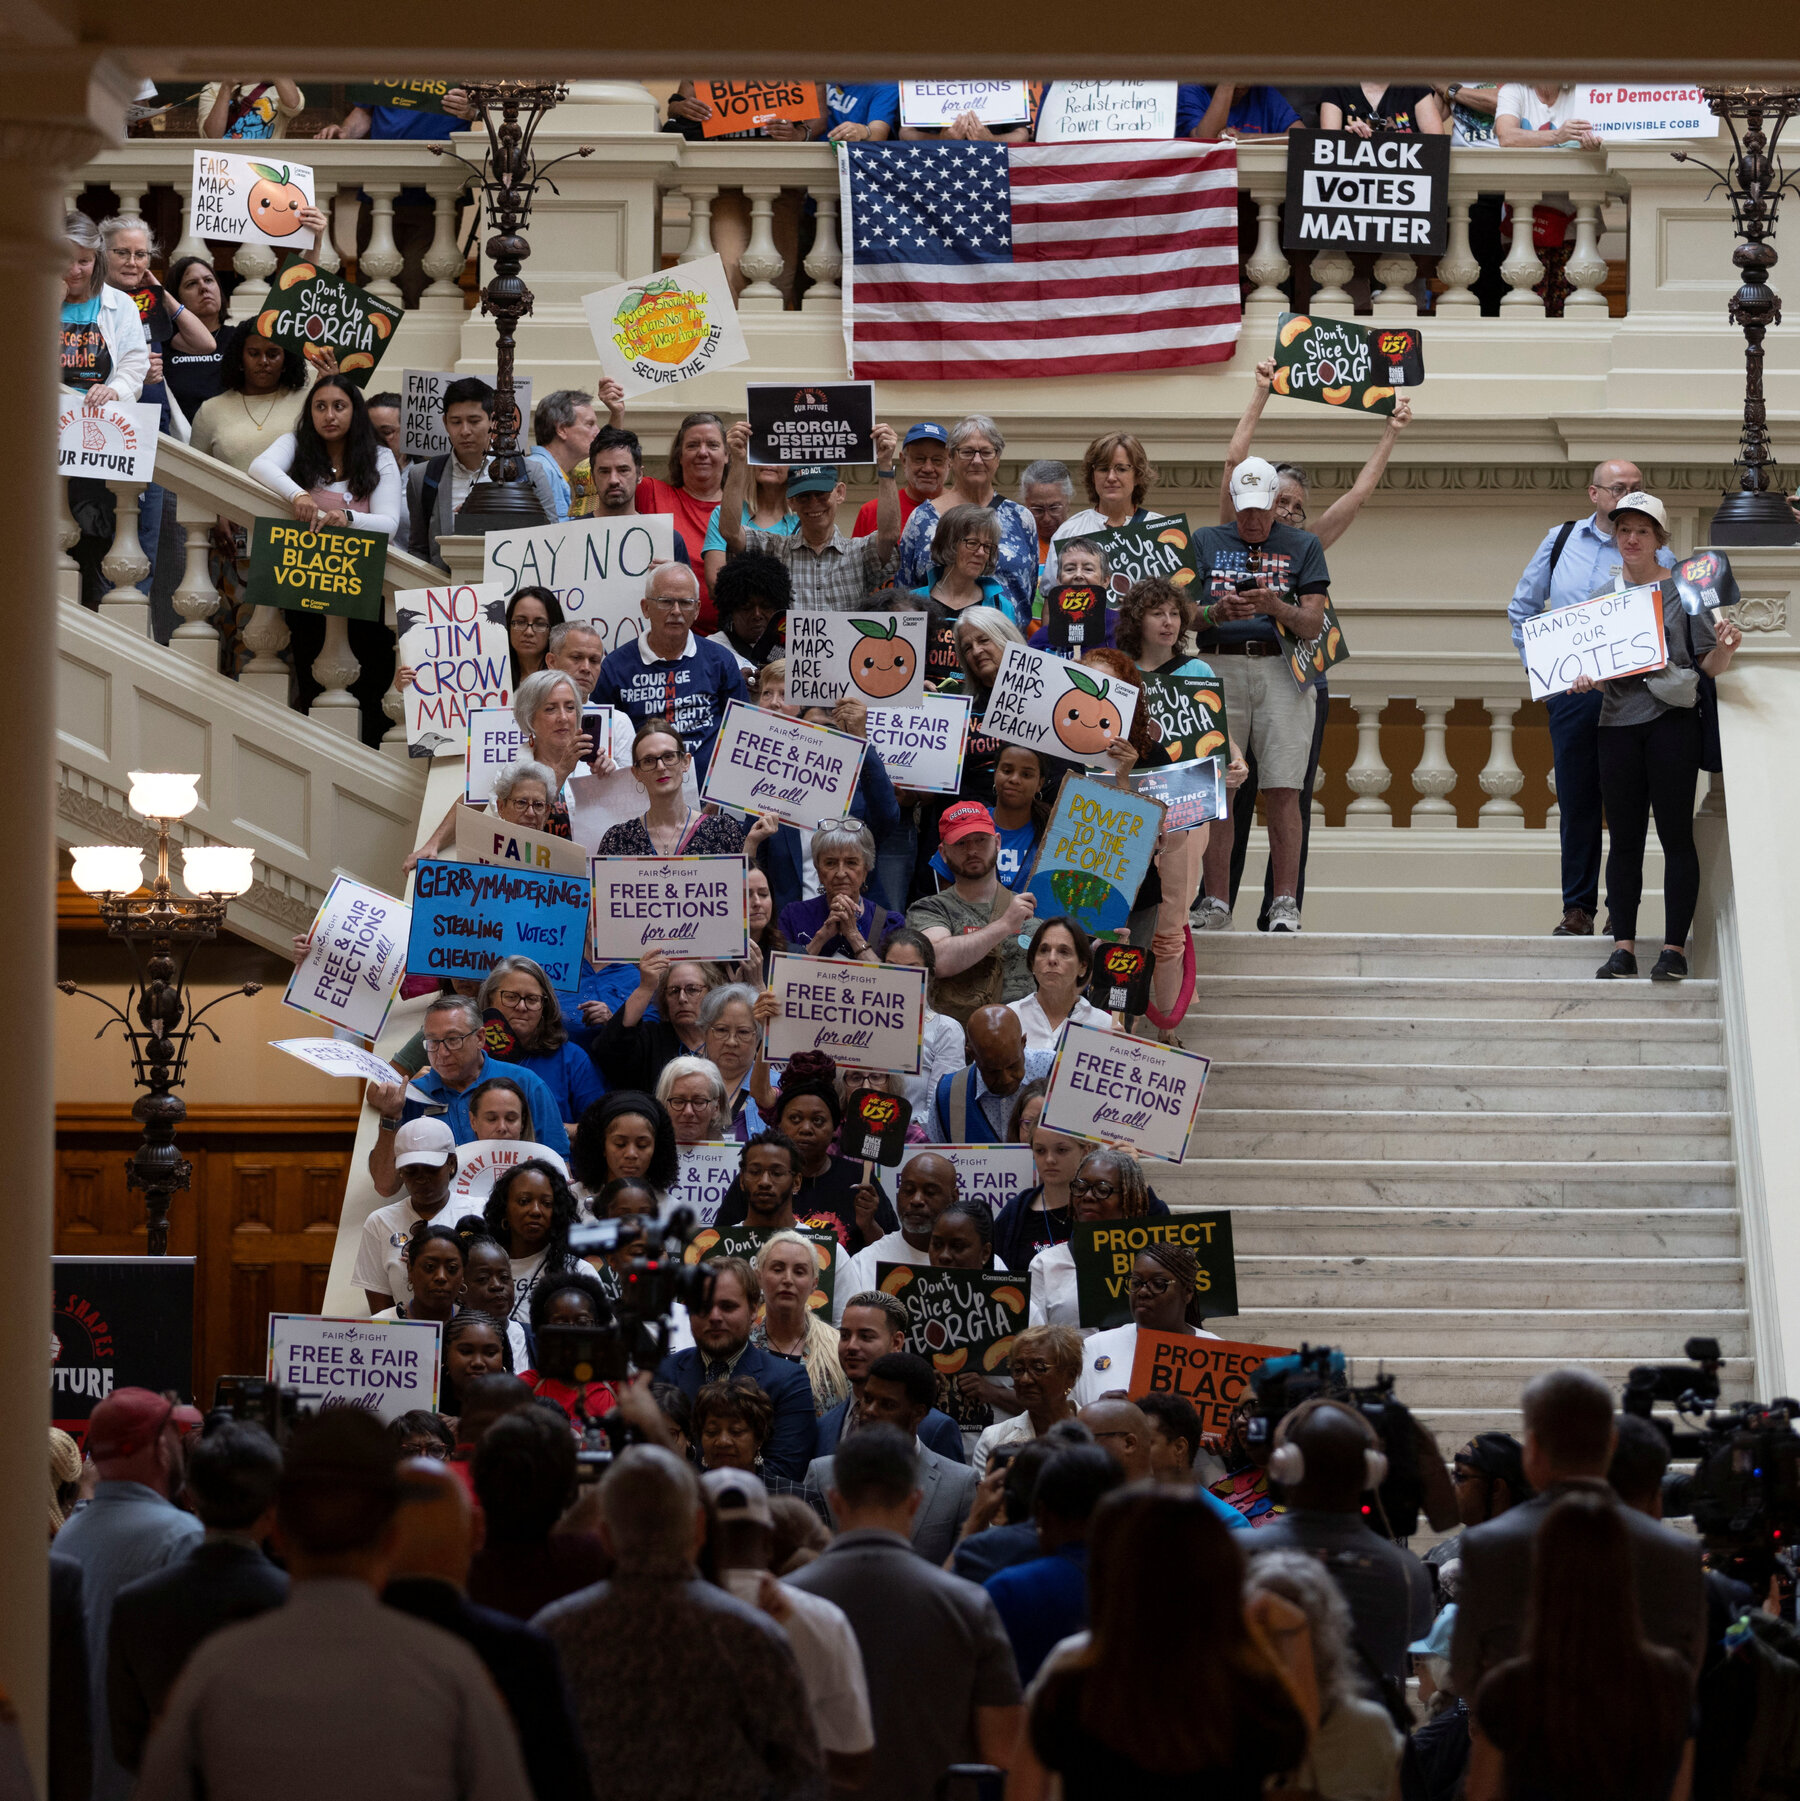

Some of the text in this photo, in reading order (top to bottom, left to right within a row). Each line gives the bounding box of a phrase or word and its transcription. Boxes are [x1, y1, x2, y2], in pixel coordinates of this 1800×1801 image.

[915, 81, 1011, 96] ELECTIONS
[1589, 87, 1705, 105] for Democracy
[714, 87, 804, 117] VOTERS
[941, 98, 988, 113] for all!
[1065, 92, 1157, 113] Redistricting
[1057, 114, 1152, 133] Power Grab
[1602, 119, 1699, 131] INDIVISIBLE COBB
[1314, 139, 1422, 169] BLACK
[200, 157, 229, 175] FAIR
[198, 177, 235, 196] MAPS
[1316, 176, 1415, 205] VOTES
[197, 197, 224, 213] ARE
[195, 213, 248, 235] PEACHY
[1300, 213, 1431, 245] MATTER
[315, 279, 345, 299] Don't
[300, 290, 364, 323] Slice Up
[276, 309, 373, 351] GEORGIA
[1314, 325, 1344, 341] Don't
[632, 325, 722, 383] SECURE THE VOTE!
[1304, 334, 1368, 364] Slice Up
[1382, 341, 1406, 353] US!
[172, 354, 213, 364] Common
[409, 376, 438, 394] FAIR
[407, 396, 444, 414] MAPS
[82, 406, 137, 450] LINE SHAPES
[406, 415, 433, 430] ARE
[773, 420, 851, 433] GEORGIA
[767, 433, 858, 446] DESERVES
[81, 451, 135, 476] FUTURE
[780, 447, 846, 459] BETTER
[1146, 518, 1182, 530] Common Cause
[270, 526, 375, 557] PROTECT
[1125, 534, 1154, 561] Up
[283, 548, 358, 575] BLACK
[492, 527, 654, 597] SAY NO
[1215, 551, 1247, 571] WE
[1687, 563, 1713, 580] US!
[274, 566, 362, 595] VOTERS
[427, 585, 478, 623] NO
[1062, 597, 1090, 611] US!
[793, 617, 827, 637] FAIR
[1525, 594, 1632, 641] HANDS OFF
[425, 622, 482, 658] JIM
[1572, 625, 1606, 646] OUR
[792, 639, 834, 658] MAPS
[792, 659, 822, 678] ARE
[1009, 650, 1042, 676] FAIR
[1530, 632, 1656, 690] VOTES
[413, 655, 507, 695] CROW
[632, 671, 690, 687] COURAGE
[1002, 671, 1044, 698] MAPS
[620, 686, 676, 702] FREEDOM
[791, 680, 850, 699] PEACHY
[645, 694, 712, 715] DIVERSITY
[995, 691, 1028, 714] ARE
[1165, 687, 1190, 716] Up
[666, 706, 713, 723] RIGHTS
[891, 714, 949, 733] & FAIR
[769, 725, 823, 746] FAIR FIGHT
[989, 711, 1049, 743] PEACHY
[736, 730, 843, 775] FREE & FAIR
[888, 751, 918, 766] all!
[731, 748, 839, 793] ELECTIONS
[751, 778, 808, 803] for all!
[949, 808, 980, 821] GEORGIA
[1068, 794, 1143, 837] POWER
[1073, 821, 1127, 855] TO THE
[493, 833, 551, 869] FAIR
[1054, 837, 1130, 881] PEOPLE
[639, 869, 698, 877] FAIR FIGHT
[610, 882, 728, 899] FREE & FAIR
[611, 901, 729, 918] ELECTIONS
[313, 914, 338, 966] FAIR FIGHT
[517, 922, 567, 946] VOTES!
[641, 922, 699, 945] for all!
[314, 900, 369, 1000] FREE & FAIR
[331, 907, 386, 1008] ELECTIONS
[362, 934, 393, 991] for all!
[1108, 958, 1136, 973] US!
[817, 972, 877, 984] FAIR FIGHT
[786, 982, 905, 1010] FREE & FAIR
[785, 1001, 904, 1030] ELECTIONS
[814, 1026, 874, 1048] for all!
[1110, 1045, 1166, 1067] FAIR FIGHT
[1075, 1052, 1187, 1096] FREE & FAIR
[869, 1097, 894, 1108] WE GOT
[1070, 1071, 1181, 1115] ELECTIONS
[863, 1103, 893, 1123] US!
[1093, 1102, 1152, 1129] for all!
[1101, 1130, 1135, 1143] fairfight.com
[457, 1151, 518, 1195] EVERY LINE
[961, 1158, 988, 1166] FIGHT
[687, 1168, 702, 1183] &
[973, 1172, 1017, 1188] FAIR
[804, 1218, 830, 1229] GOT
[1093, 1222, 1216, 1252] PROTECT
[918, 1272, 955, 1296] Don't
[982, 1274, 1008, 1282] Common
[907, 1282, 985, 1322] Slice Up
[65, 1294, 114, 1357] SHAPES
[322, 1332, 388, 1342] FAIR FIGHT
[289, 1344, 418, 1367] FREE & FAIR
[288, 1365, 418, 1389] ELECTIONS
[350, 1392, 385, 1411] all!
